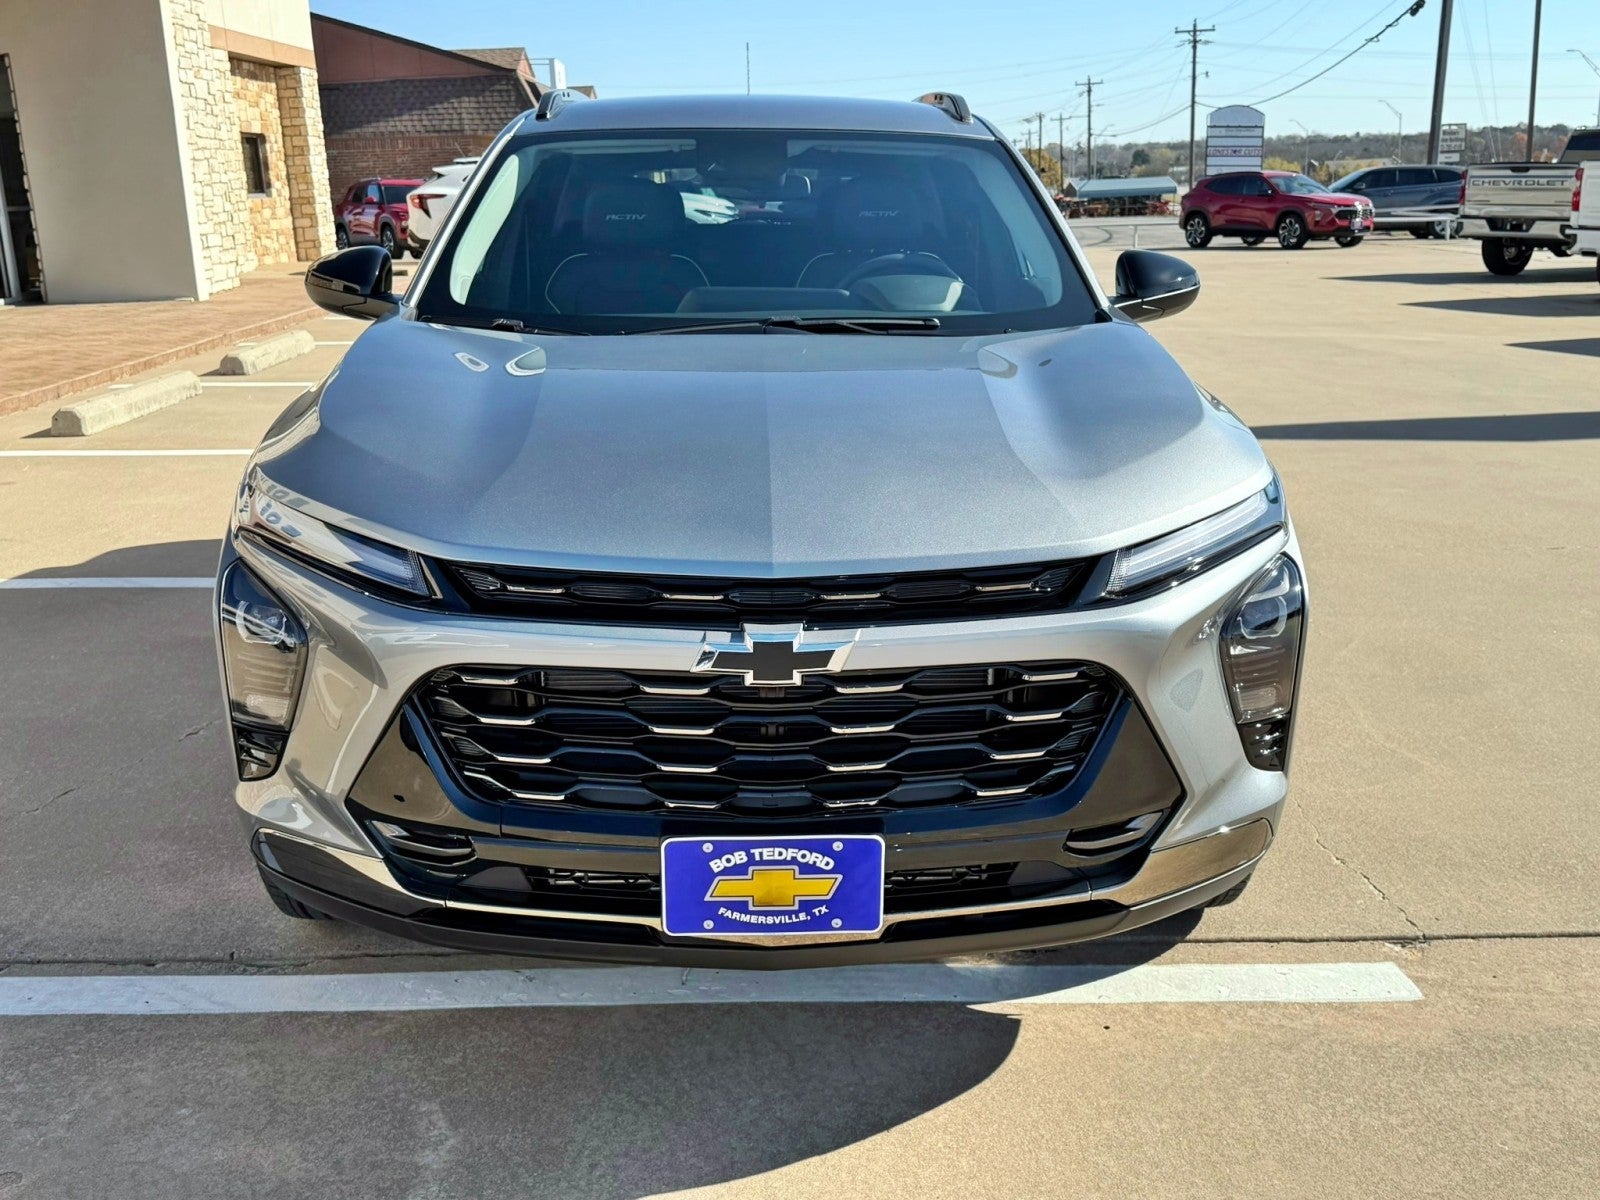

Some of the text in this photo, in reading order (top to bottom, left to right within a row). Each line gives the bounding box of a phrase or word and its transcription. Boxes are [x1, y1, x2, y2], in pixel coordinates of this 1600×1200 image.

[1471, 179, 1568, 187] CHEVROLET
[709, 848, 835, 873] BOB TEDFORD
[718, 905, 829, 924] FARMERSVILLE, TX
